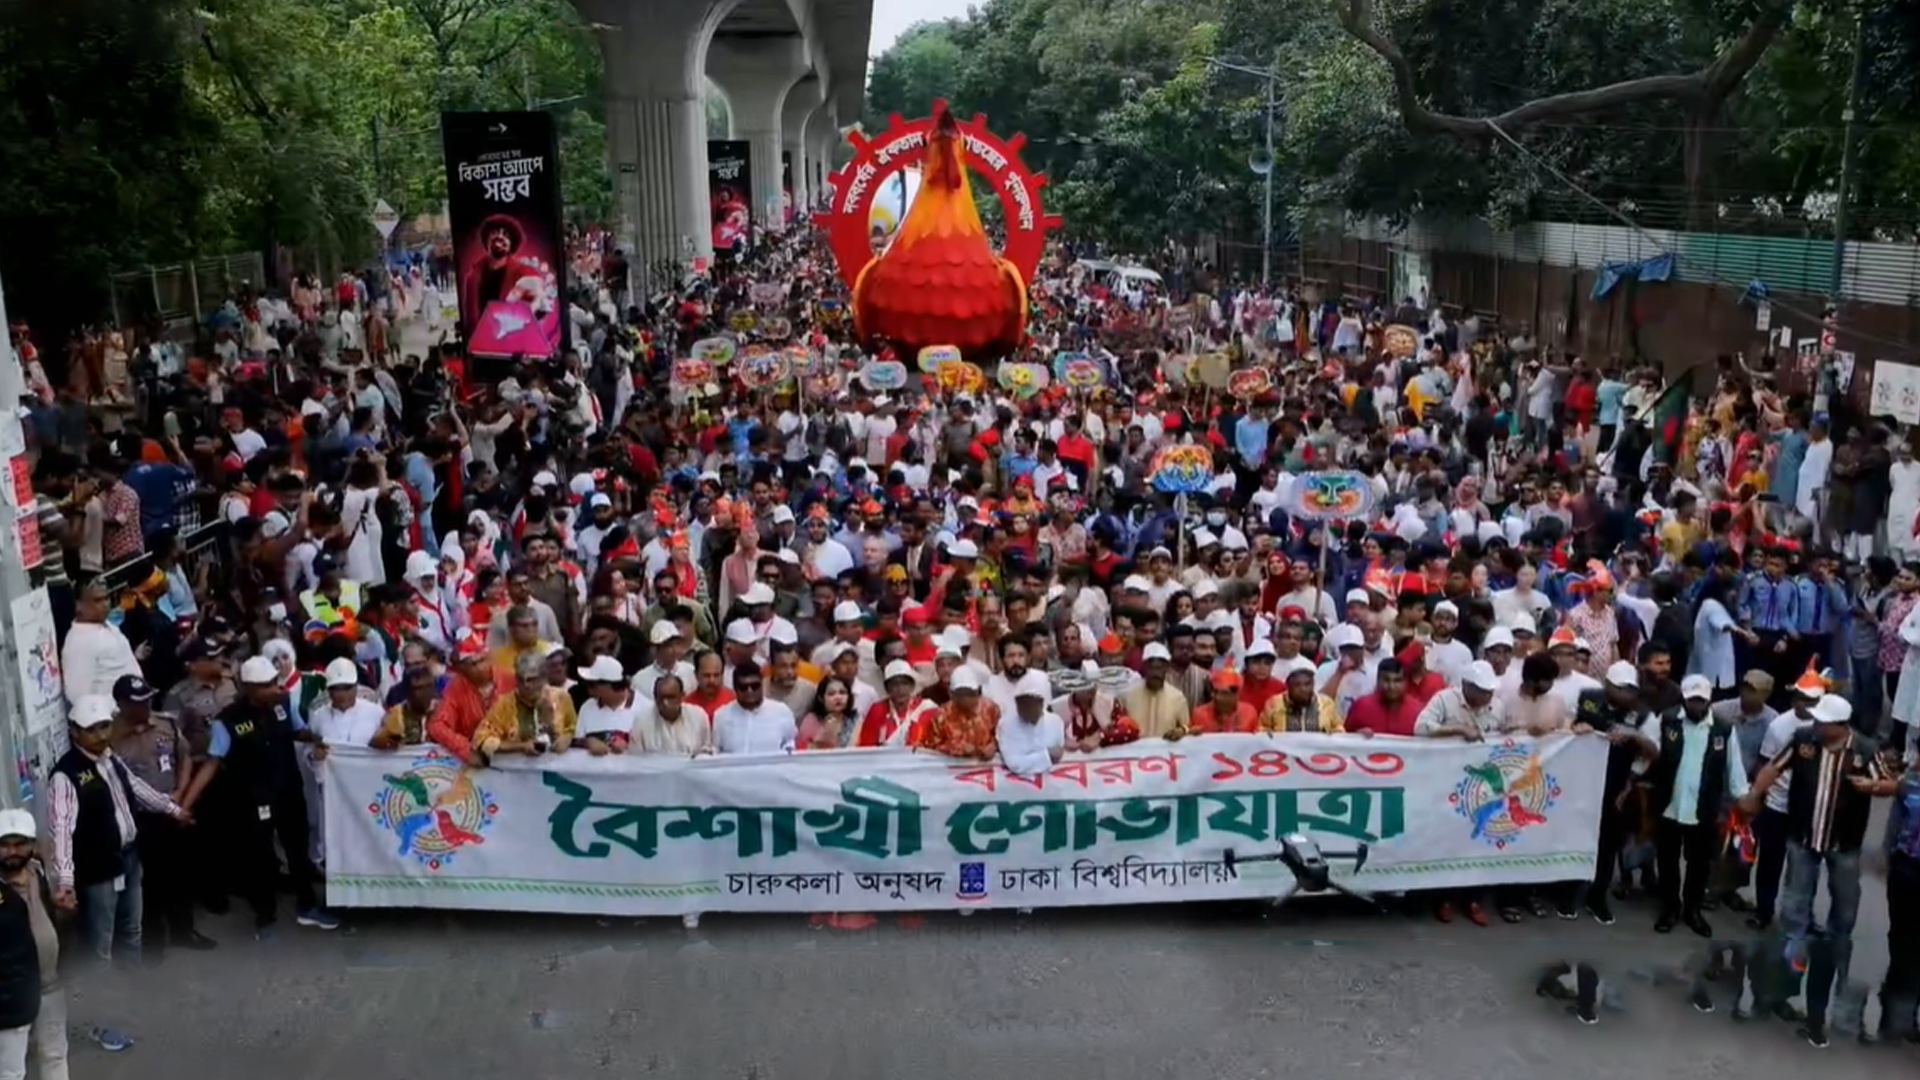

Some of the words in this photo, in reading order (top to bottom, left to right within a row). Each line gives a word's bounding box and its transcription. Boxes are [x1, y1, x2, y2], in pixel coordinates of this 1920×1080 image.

[458, 161, 500, 182] বিকাশ
[482, 174, 530, 203] সম্ভব
[235, 720, 254, 736] DU
[1212, 749, 1405, 782] ১৪৩৩
[542, 769, 931, 859] বৈশাখী
[945, 786, 1405, 855] শোভাযাত্রা
[725, 870, 843, 896] চারুকলা
[853, 871, 945, 900] অনুষদ
[1000, 864, 1061, 892] ঢাকা
[1071, 855, 1230, 891] বিশ্ববিদ্যালয়
